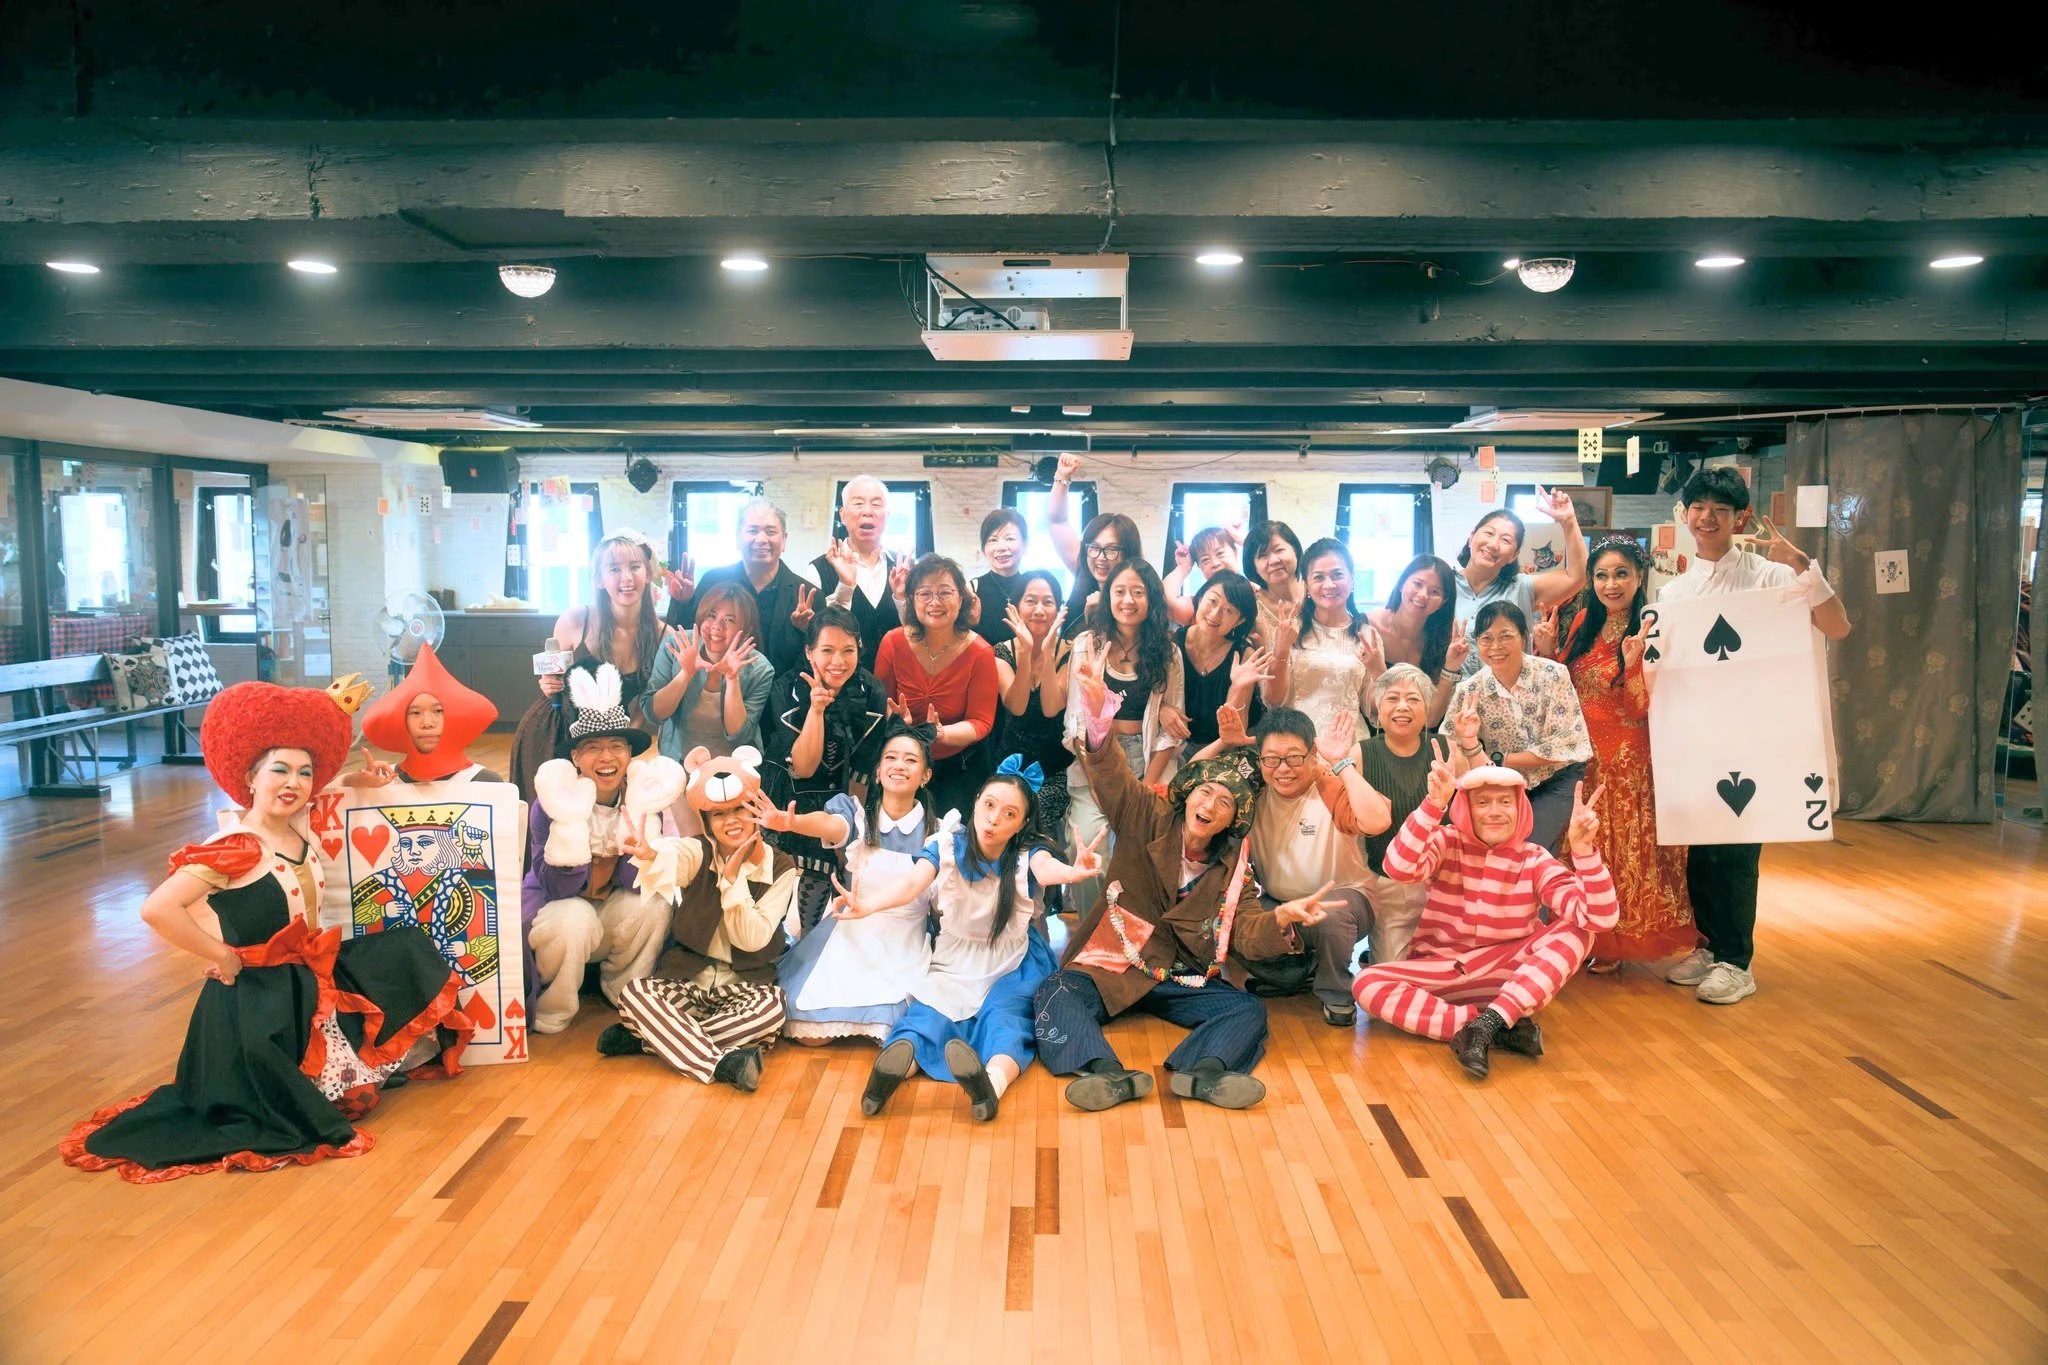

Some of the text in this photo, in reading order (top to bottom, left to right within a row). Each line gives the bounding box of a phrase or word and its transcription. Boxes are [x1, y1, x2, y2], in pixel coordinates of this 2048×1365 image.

[1641, 609, 1660, 639] 2
[319, 793, 345, 832] K
[1805, 799, 1829, 831] 2
[503, 1025, 528, 1060] K
